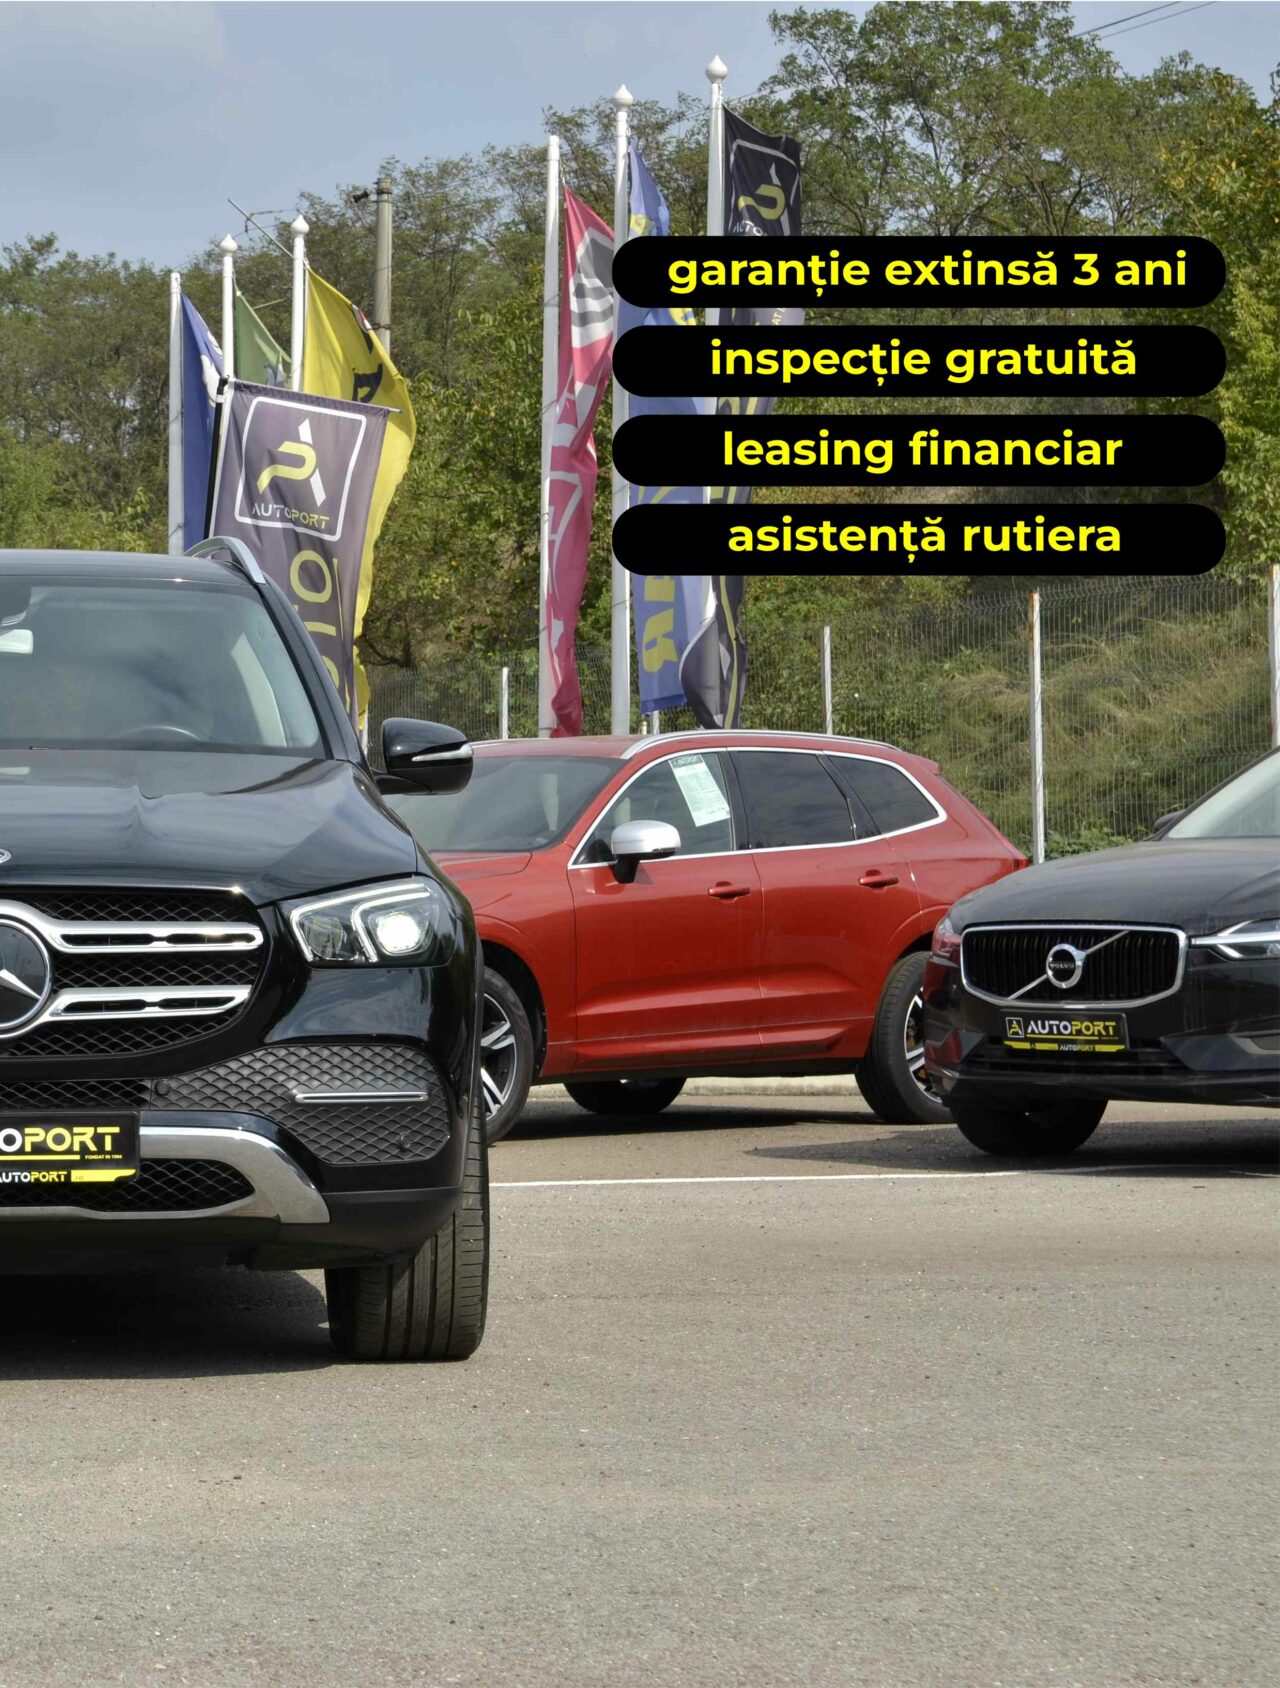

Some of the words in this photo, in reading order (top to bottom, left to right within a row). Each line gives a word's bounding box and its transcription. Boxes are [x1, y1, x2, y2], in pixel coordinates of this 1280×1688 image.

[252, 502, 330, 530] AUTOPORT
[1027, 1020, 1117, 1036] AUTOPORT
[1059, 1043, 1094, 1052] AUTOPORT
